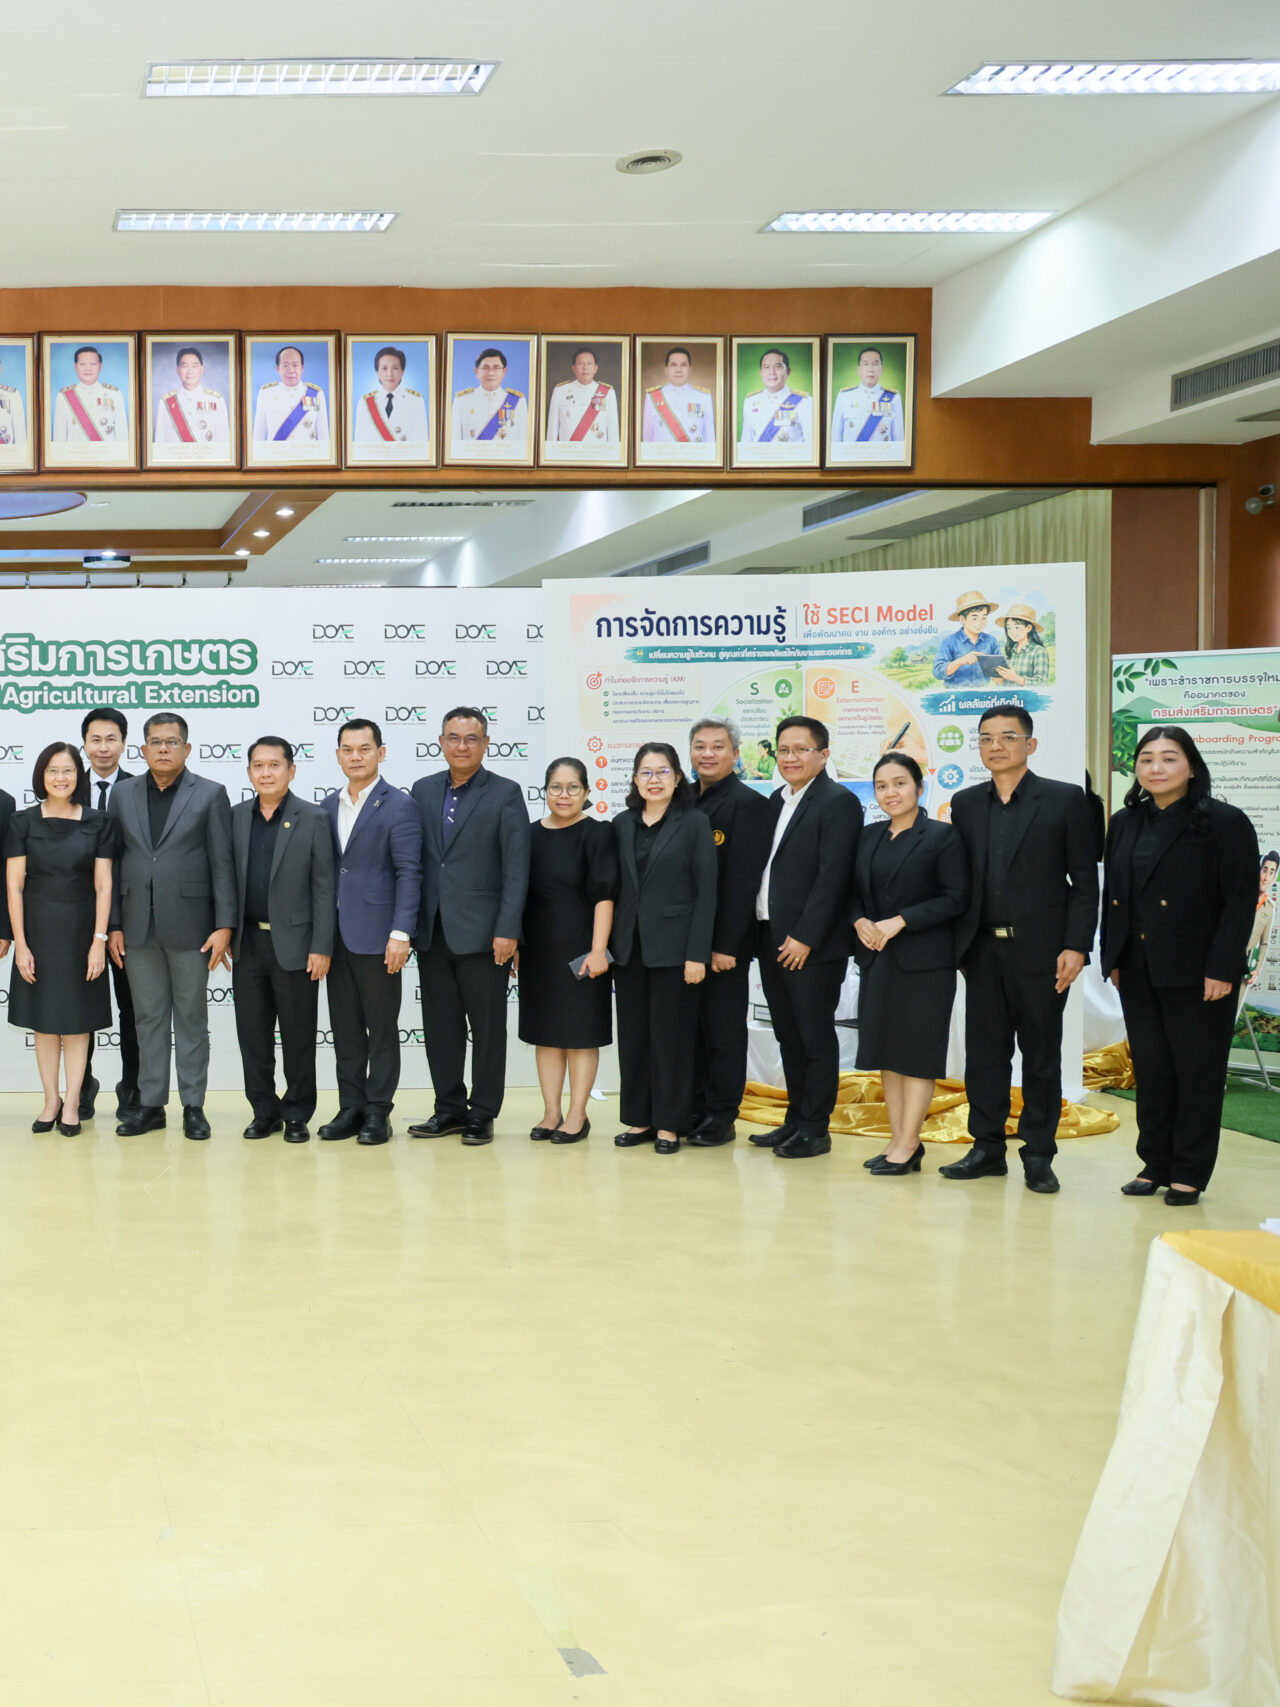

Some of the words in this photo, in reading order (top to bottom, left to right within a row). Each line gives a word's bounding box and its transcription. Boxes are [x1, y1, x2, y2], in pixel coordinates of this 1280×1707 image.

[803, 603, 821, 625] ใช้
[827, 606, 869, 625] SECI
[877, 603, 934, 623] Model
[596, 607, 787, 643] การจัดการความรู้
[872, 627, 897, 636] องค์กร
[750, 682, 760, 696] S
[851, 680, 859, 693] E
[3, 683, 136, 709] Agricultural
[145, 682, 256, 704] Extension
[835, 696, 885, 704] Externalization
[1183, 689, 1246, 700] คืออนาคตของ
[1192, 735, 1245, 745] nboarding
